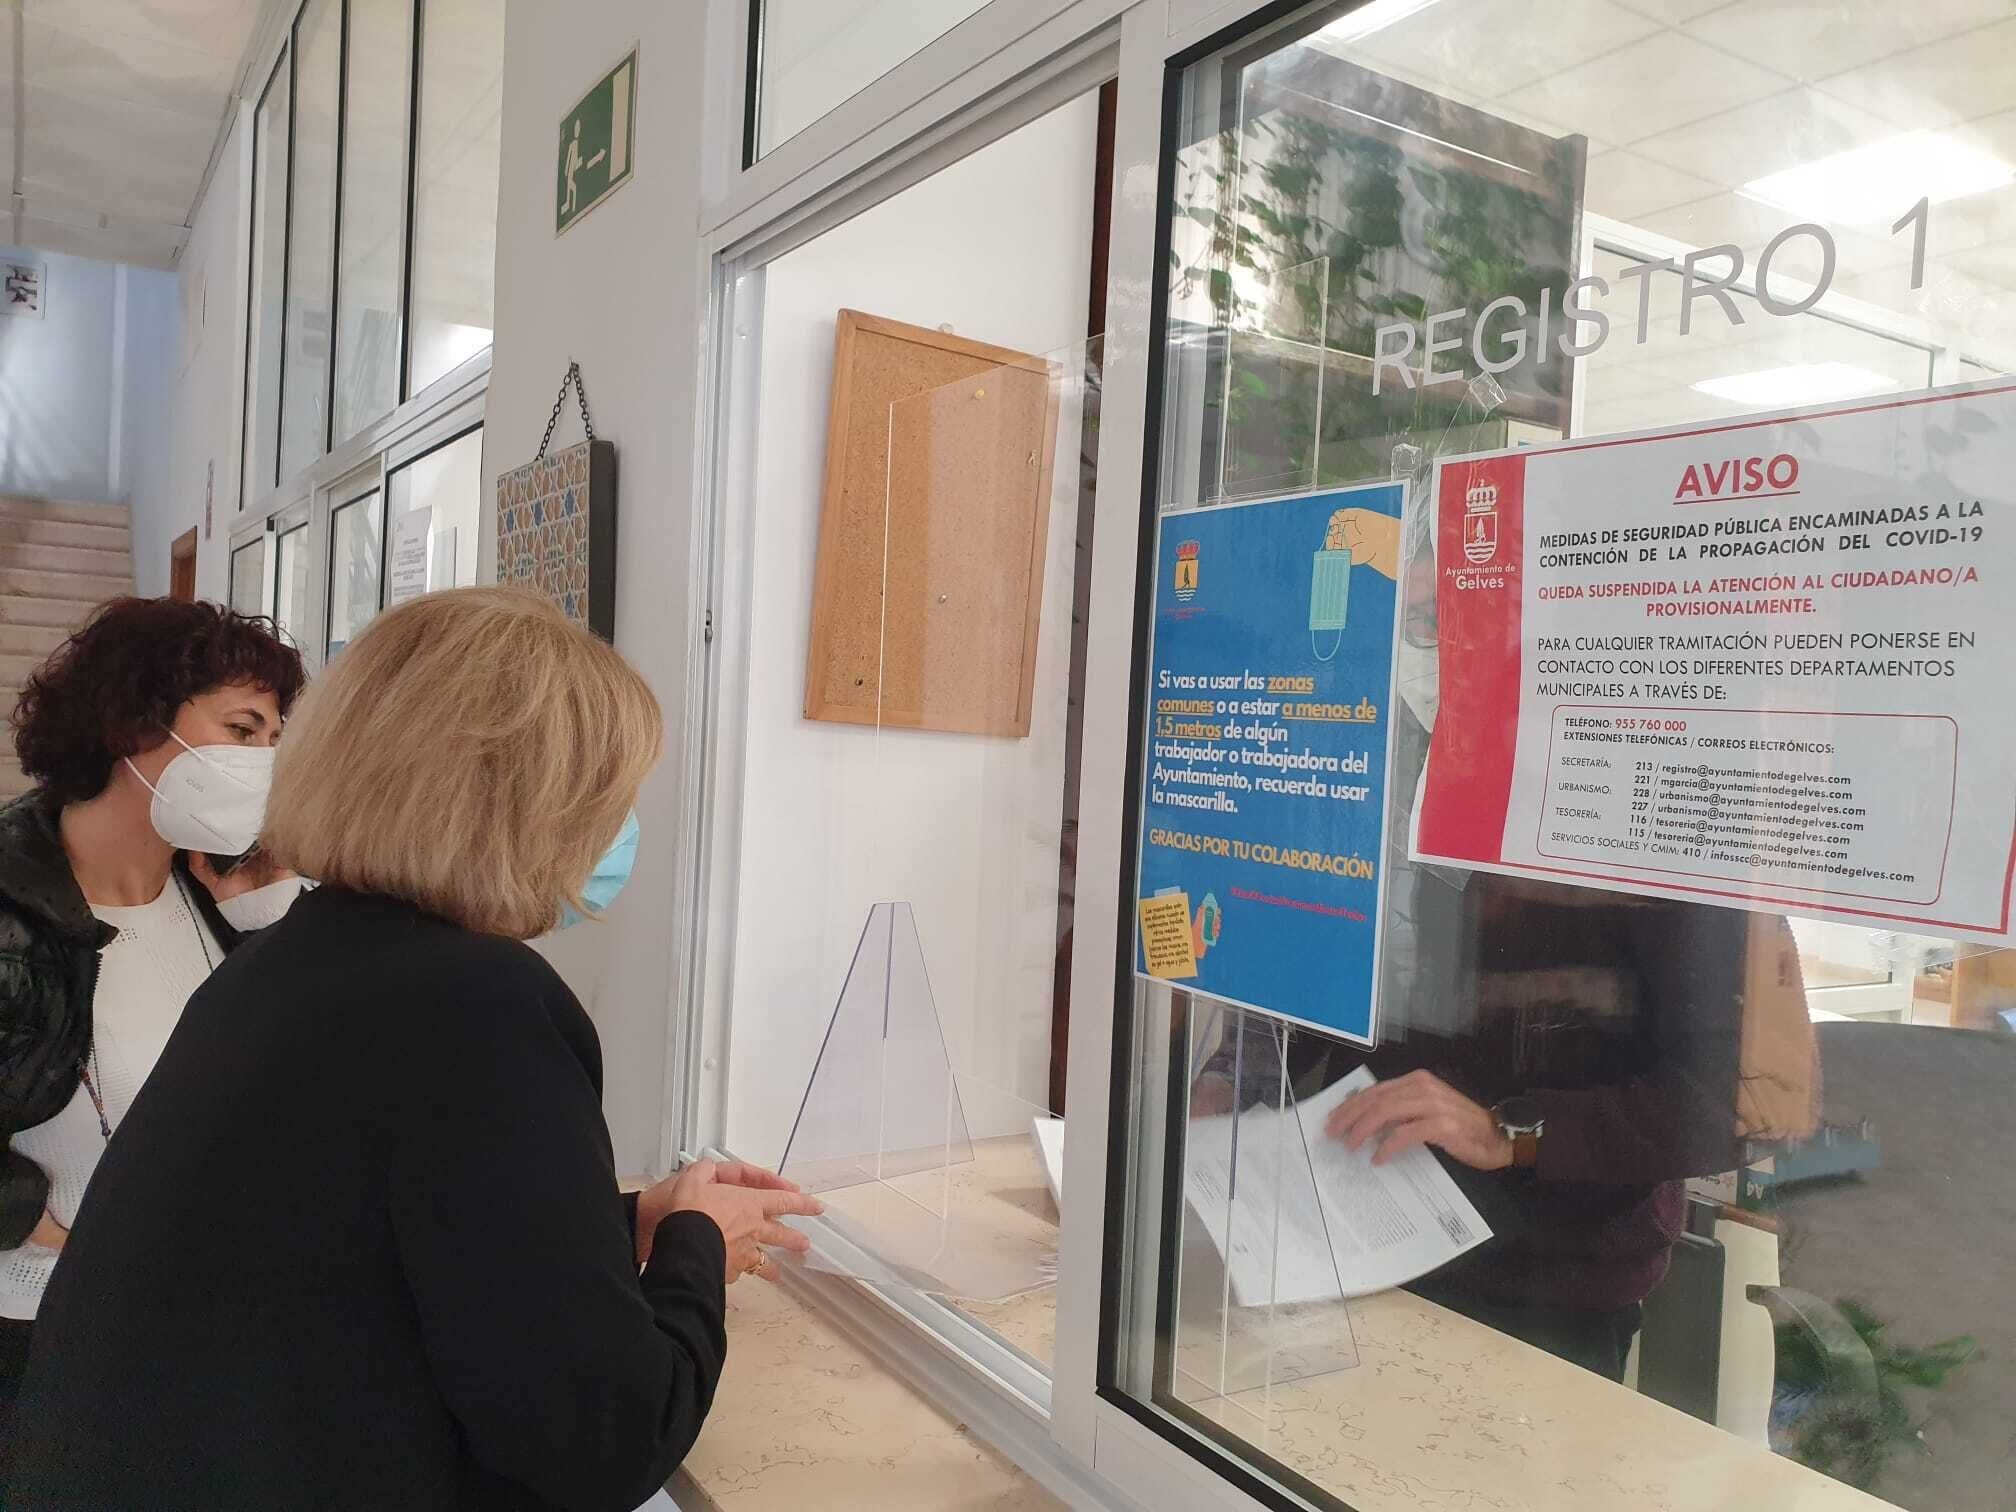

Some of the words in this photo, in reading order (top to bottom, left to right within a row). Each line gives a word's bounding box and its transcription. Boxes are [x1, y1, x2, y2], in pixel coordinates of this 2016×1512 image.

[1371, 222, 1836, 396] REGISTRO
[1891, 196, 1930, 290] 1
[1675, 453, 1799, 498] AVISO
[1540, 531, 1597, 548] MEDIDAS
[1601, 530, 1618, 544] DE
[1623, 523, 1709, 542] SEGURIDAD
[1714, 517, 1782, 537] PÚBLICA
[1788, 505, 1929, 531] ENCAMINADAS
[1936, 503, 1950, 520] A
[1958, 501, 1984, 518] LA
[1539, 548, 1628, 568] CONTENCIÓN
[1639, 548, 1657, 562] DE
[1668, 546, 1687, 560] LA
[1700, 534, 1824, 558] PROPAGACIÓN
[1838, 534, 1870, 550] DEL
[1886, 526, 1983, 547] COVID-19
[1446, 565, 1503, 578] Ayuntamiento
[1505, 563, 1516, 572] de
[1456, 575, 1505, 590] Gelves
[1538, 585, 1584, 600] QUEDA
[1588, 581, 1677, 598] SUSPENDIDA
[1683, 580, 1702, 594] LA
[1708, 573, 1796, 593] ATENCIÓN
[1802, 575, 1825, 590] AL
[1831, 566, 1978, 588] CIUDADANO/A
[1646, 598, 1816, 617] PROVISIONALMENTE.
[1538, 637, 1571, 651] PARA
[1575, 636, 1653, 652] CUALQUIER
[1659, 631, 1767, 650] TRAMITACIÓN
[1774, 633, 1843, 650] PUEDEN
[1850, 632, 1940, 649] PONERSE
[1948, 631, 1975, 648] EN
[1159, 670, 1171, 689] Si
[1173, 676, 1195, 689] vas
[1198, 676, 1207, 689] a
[1210, 676, 1242, 690] usar
[1244, 669, 1265, 690] las
[1268, 677, 1314, 691] zonas
[1537, 660, 1614, 674] CONTACTO
[1619, 660, 1654, 674] CON
[1659, 660, 1688, 674] LOS
[1693, 660, 1784, 676] DIFERENTES
[1790, 660, 1955, 677] DEPARTAMENTOS
[1536, 683, 1624, 698] MUNICIPALES
[1629, 684, 1639, 698] A
[1645, 681, 1698, 700] TRAVÉS
[1703, 685, 1727, 700] DE:
[1158, 699, 1214, 713] comunes
[1217, 701, 1226, 714] o
[1228, 701, 1238, 714] a
[1241, 698, 1280, 715] estar
[1282, 702, 1293, 716] a
[1296, 703, 1351, 719] menos
[1355, 696, 1377, 719] de
[1175, 720, 1221, 737] metros
[1224, 719, 1242, 739] de
[1244, 719, 1288, 746] algún
[1565, 717, 1612, 729] TELÉFONO:
[1615, 719, 1635, 729] 955
[1639, 720, 1660, 731] 760
[1664, 721, 1687, 732] 000
[1563, 731, 1623, 743] EXTENSIONES
[1625, 732, 1687, 747] TELEFÓNICAS
[1690, 737, 1695, 748] /
[1697, 738, 1746, 750] CORREOS
[1749, 740, 1835, 754] ELECTRÓNICOS:
[1155, 741, 1228, 765] trabajador
[1229, 750, 1238, 763] o
[1242, 746, 1338, 773] trabajadora
[1341, 750, 1368, 774] del
[1153, 762, 1252, 793] Ayuntamiento,
[1255, 775, 1327, 797] recuerda
[1330, 784, 1370, 801] usar
[1636, 761, 1653, 771] 213
[1662, 764, 1851, 785] registro@ayuntamientodegelves.com
[1152, 784, 1164, 803] la
[1166, 790, 1238, 813] mascarilla.
[1634, 775, 1650, 785] 221
[1661, 778, 1853, 800] mgarcia@ayuntamientodegelves.com
[1633, 788, 1650, 798] 228
[1659, 791, 1866, 816] urbanismo@ayuntamientodegelves.com
[1630, 814, 1647, 824] 116
[1656, 817, 1851, 845] tesoreria@ayuntamientodegelves.com
[1631, 802, 1648, 811] 227
[1657, 805, 1864, 831] urbanismo@ayuntamientodegelves.com
[1150, 828, 1201, 852] GRACIAS
[1203, 836, 1230, 857] POR
[1232, 840, 1250, 860] TU
[1252, 843, 1374, 880] COLABORACIÓN
[1628, 827, 1645, 838] 115
[1654, 831, 1848, 859] tesoreria@ayuntamientodegelves.com
[1551, 832, 1595, 846] SERVICIOS
[1597, 837, 1640, 851] SOCIALES
[1643, 843, 1649, 851] Y
[1682, 848, 1701, 858] 410
[1710, 850, 1915, 883] infosscc@ayuntamientodegelves.com
